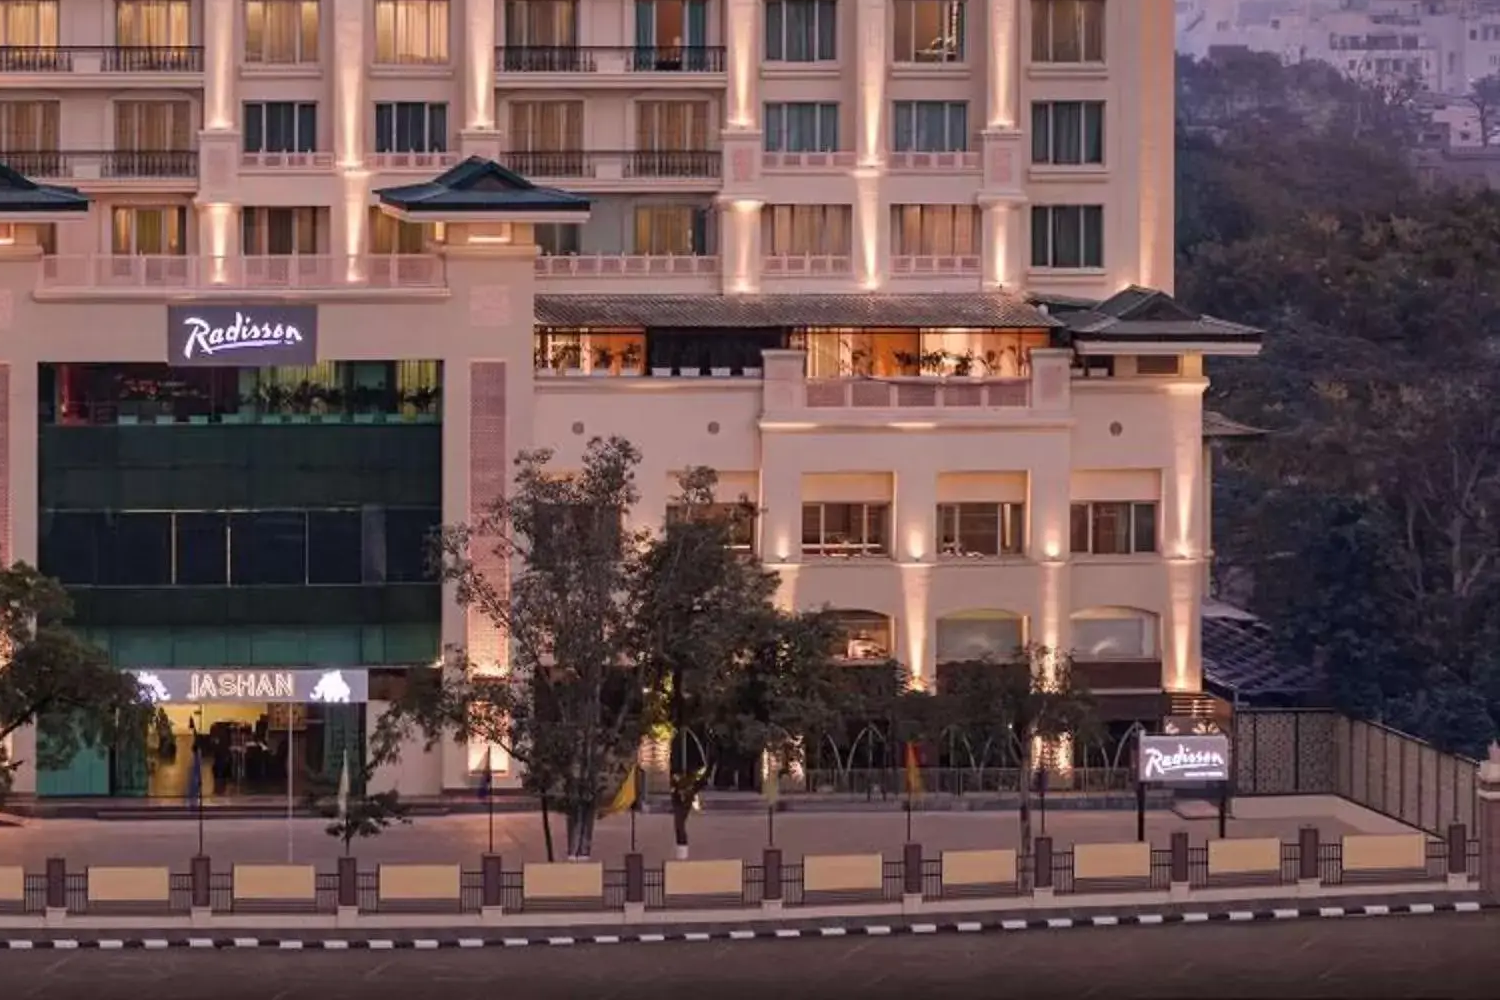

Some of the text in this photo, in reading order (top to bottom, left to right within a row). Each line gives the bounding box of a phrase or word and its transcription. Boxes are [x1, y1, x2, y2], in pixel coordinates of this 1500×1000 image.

[183, 312, 303, 359] Radisson
[187, 671, 295, 699] JASHAN
[1145, 744, 1224, 777] Radisson
